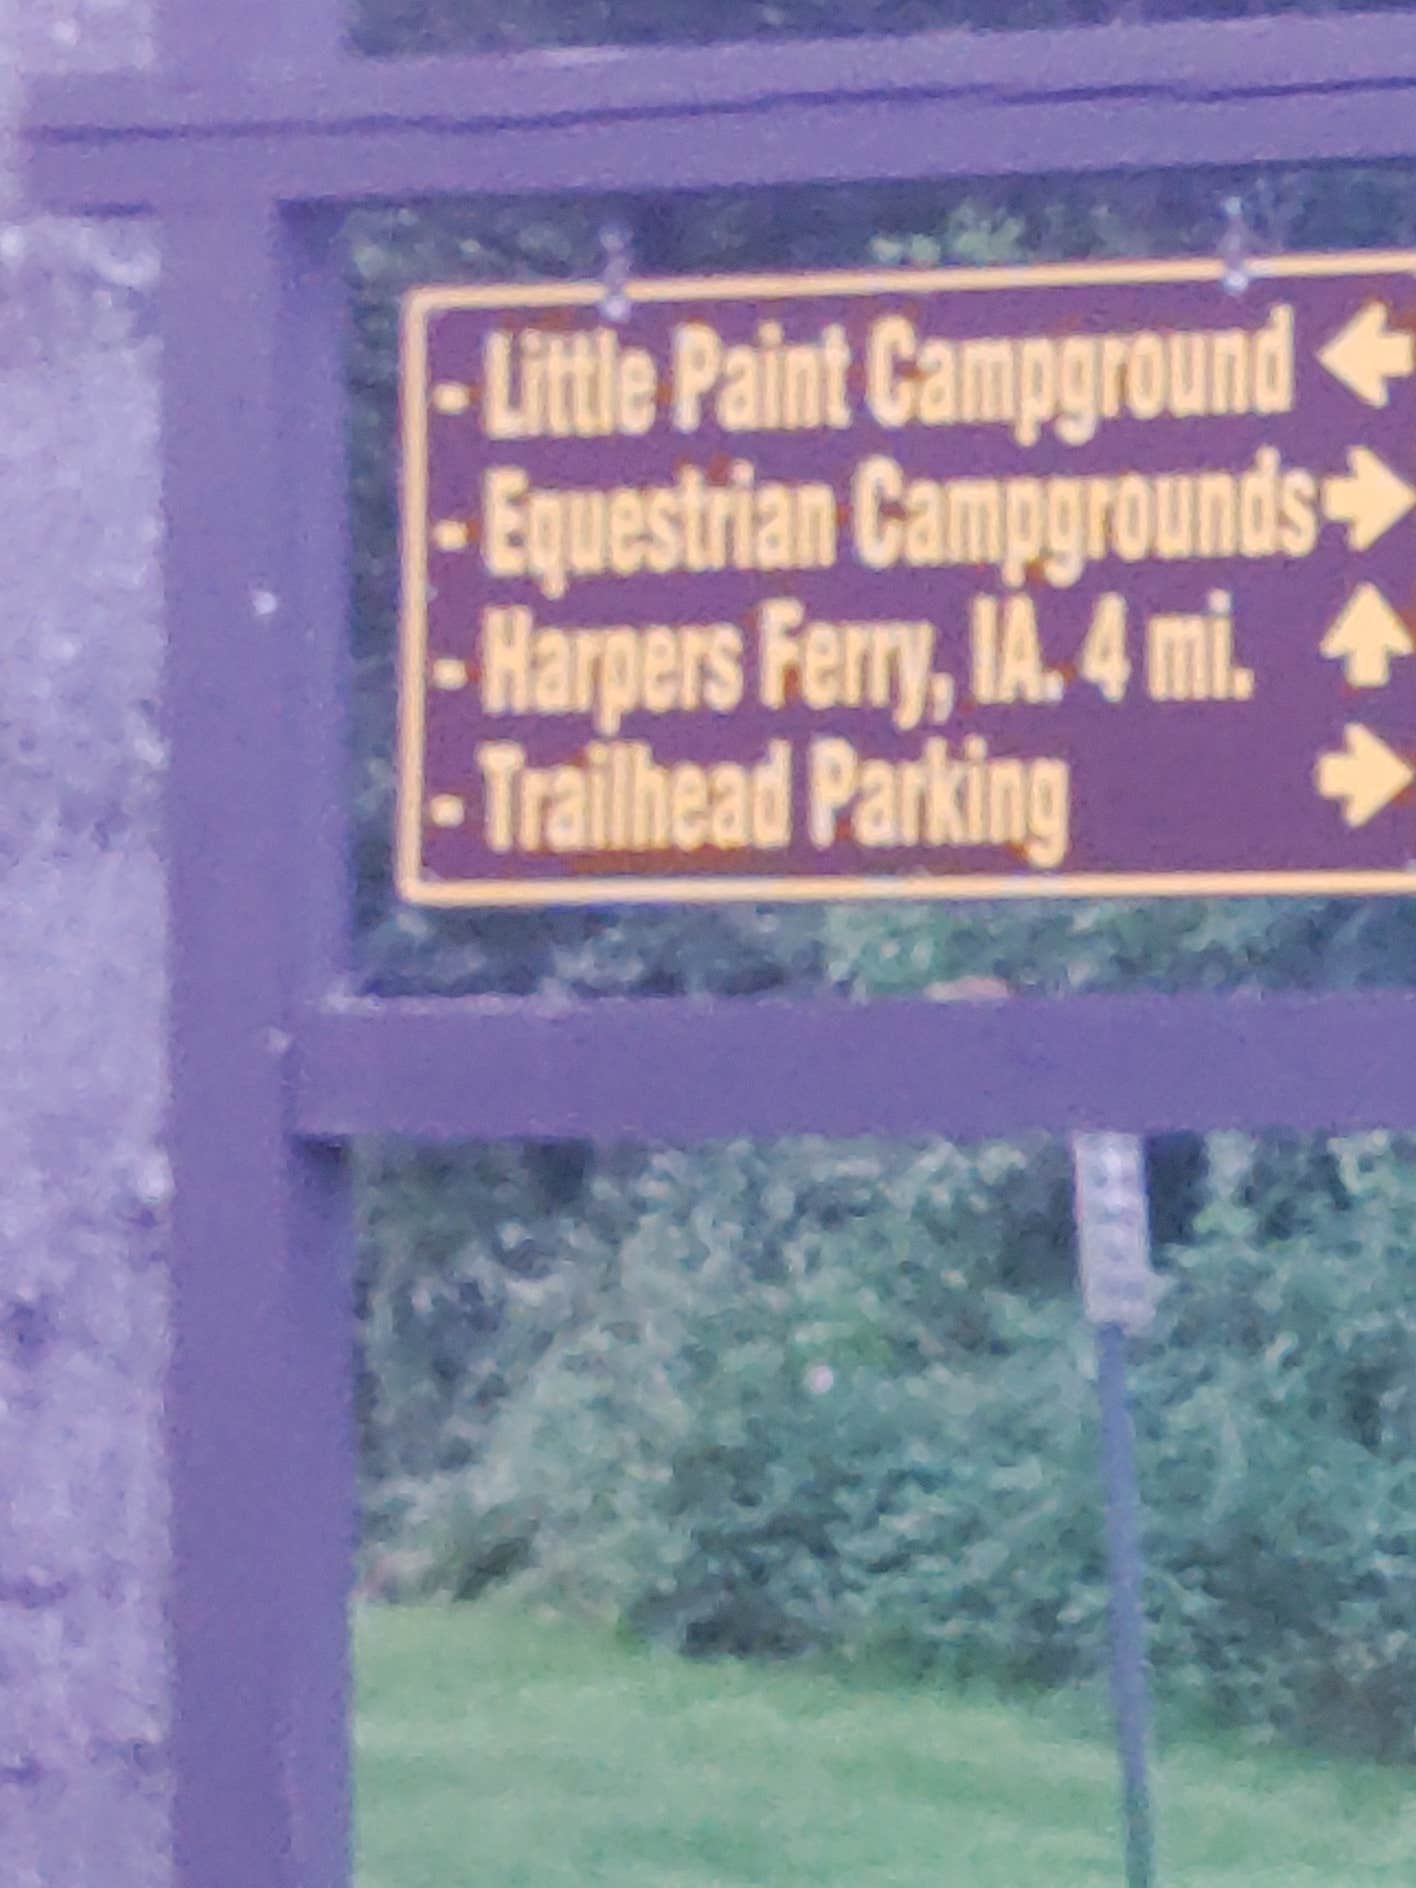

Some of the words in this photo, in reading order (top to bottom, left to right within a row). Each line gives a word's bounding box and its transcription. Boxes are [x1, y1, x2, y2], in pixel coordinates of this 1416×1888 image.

[482, 327, 658, 439] Little
[673, 322, 851, 431] Paint
[867, 303, 1294, 446] Campground
[482, 462, 837, 598] Equestrian
[853, 447, 1318, 588] Campgrounds
[481, 603, 744, 735] Harpers
[760, 596, 953, 730] Ferry,
[971, 593, 1062, 704] IA.
[1082, 592, 1129, 703] 4
[1148, 590, 1254, 702] mi.
[477, 740, 791, 853] Trailhead
[810, 736, 1070, 867] Parking
